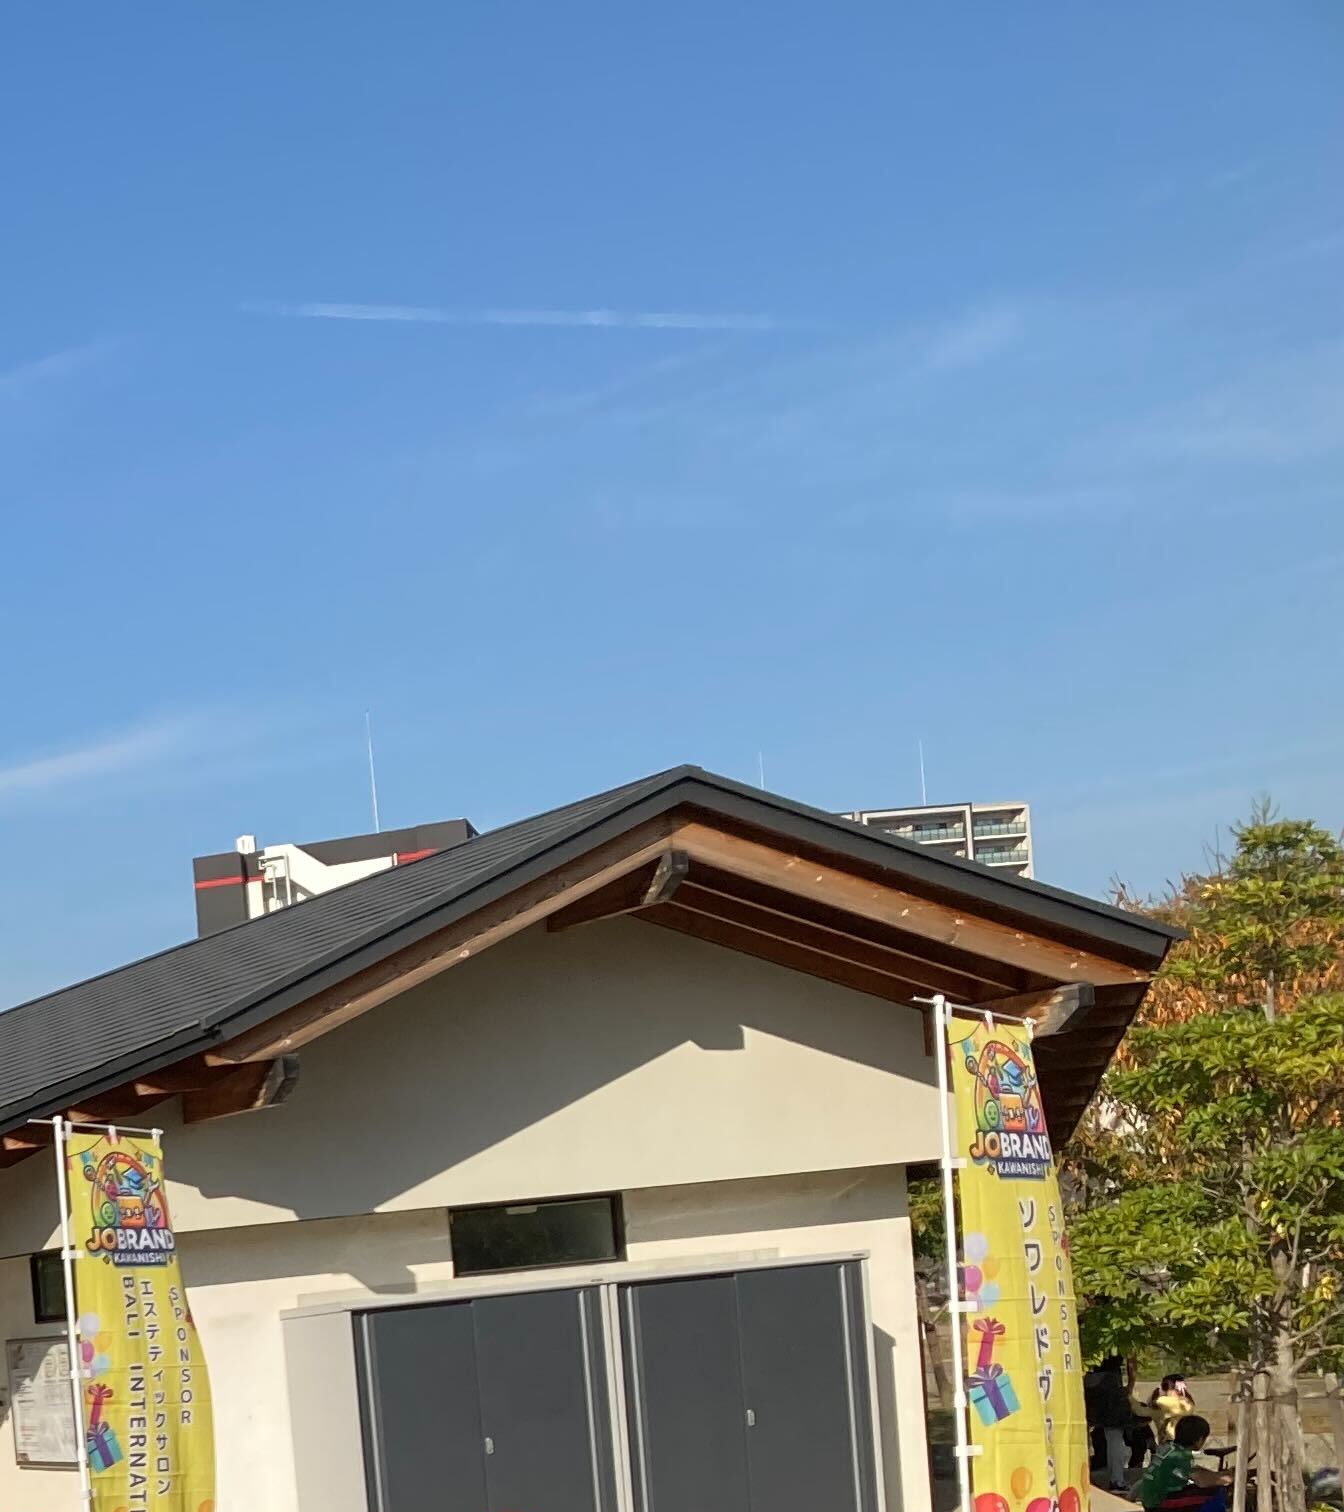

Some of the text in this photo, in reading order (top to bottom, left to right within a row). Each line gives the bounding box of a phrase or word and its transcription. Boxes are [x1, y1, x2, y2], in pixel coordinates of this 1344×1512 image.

[970, 1132, 1051, 1160] JOBRAND
[86, 1227, 175, 1251] JOBRAND
[114, 1252, 166, 1264] KAWANISHI
[122, 1276, 140, 1337] BALI
[1048, 1205, 1073, 1370] SPONSOR
[169, 1286, 192, 1424] SPONSOR
[140, 1280, 171, 1495] エステティックサロン
